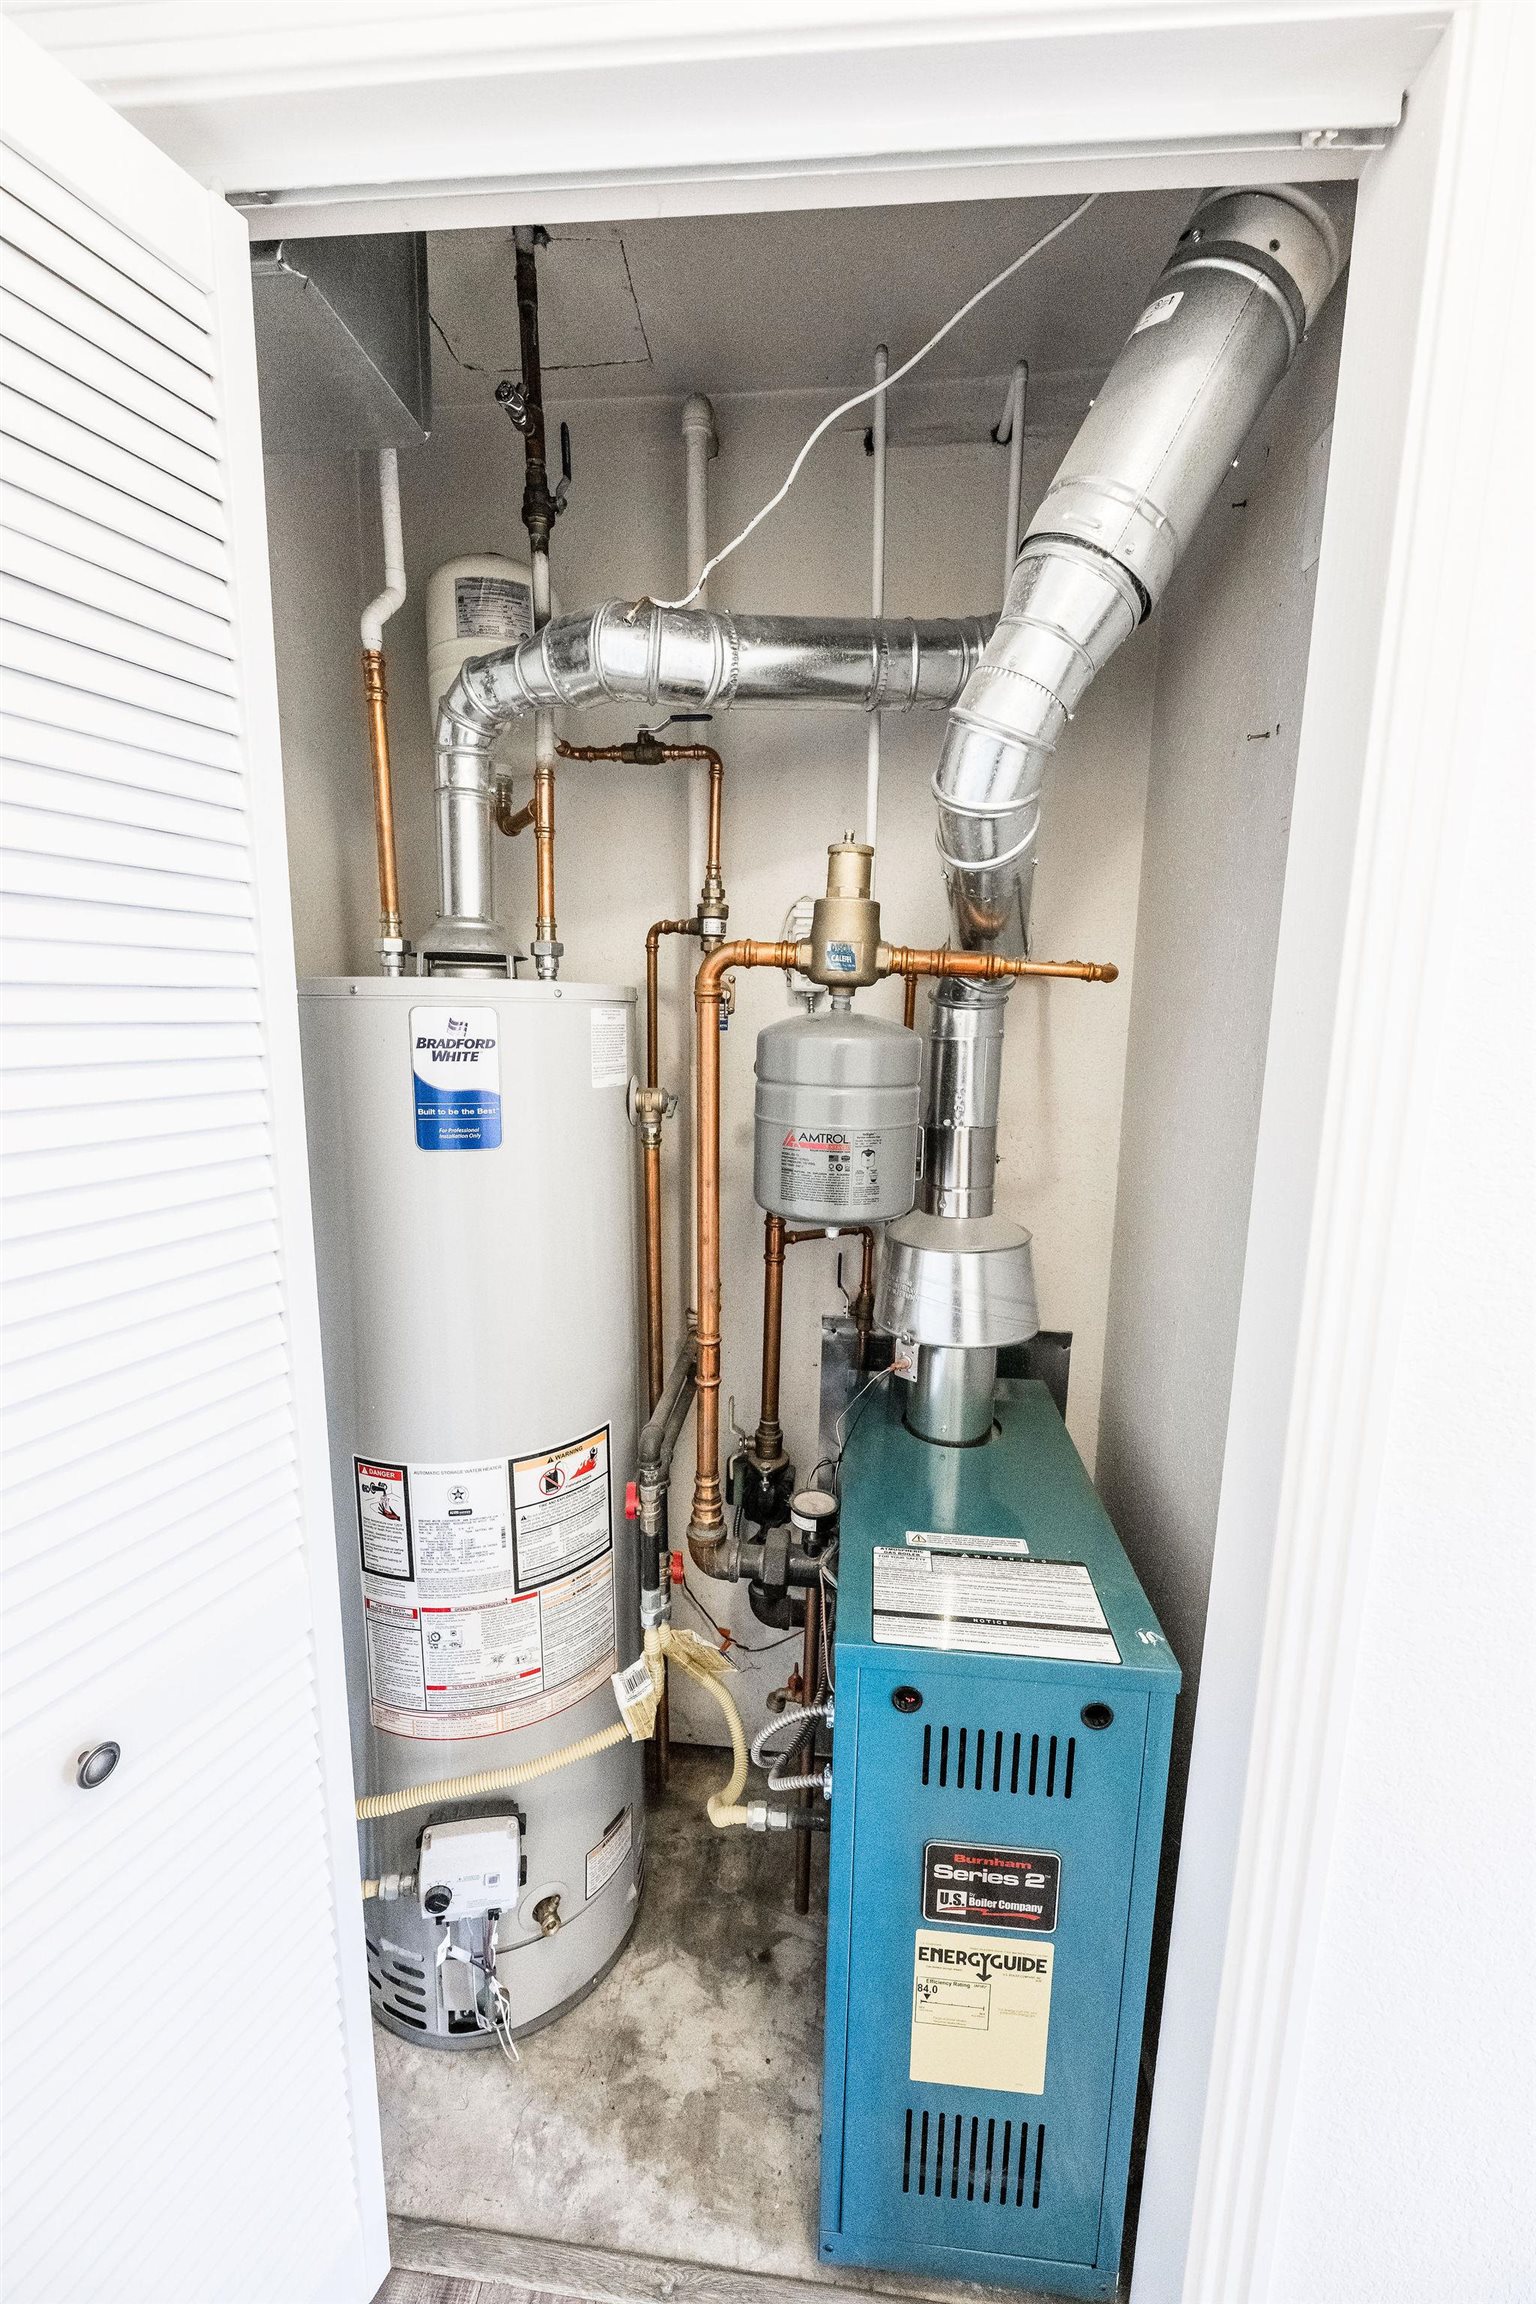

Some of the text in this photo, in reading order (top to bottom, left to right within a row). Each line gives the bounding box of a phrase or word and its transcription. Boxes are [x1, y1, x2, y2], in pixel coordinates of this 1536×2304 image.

[416, 1037, 496, 1049] BRADFORD
[431, 1050, 479, 1062] WHITE
[798, 1132, 849, 1145] AMTROL
[554, 1446, 584, 1460] WARNING
[369, 1469, 395, 1478] DANGER
[482, 1464, 502, 1472] HEATER
[973, 1554, 1047, 1564] WARNING
[973, 1618, 1009, 1626] NOTICE
[953, 1853, 1032, 1869] Burnham
[933, 1863, 1019, 1886] Series
[939, 1891, 966, 1906] U.S.
[968, 1897, 1043, 1914] Boiler Company
[918, 1946, 1048, 1982] ENERGYGUIDE
[917, 1984, 938, 1993] 84.0
[926, 1979, 952, 1987] Efficiency
[953, 1981, 971, 1989] Rating
